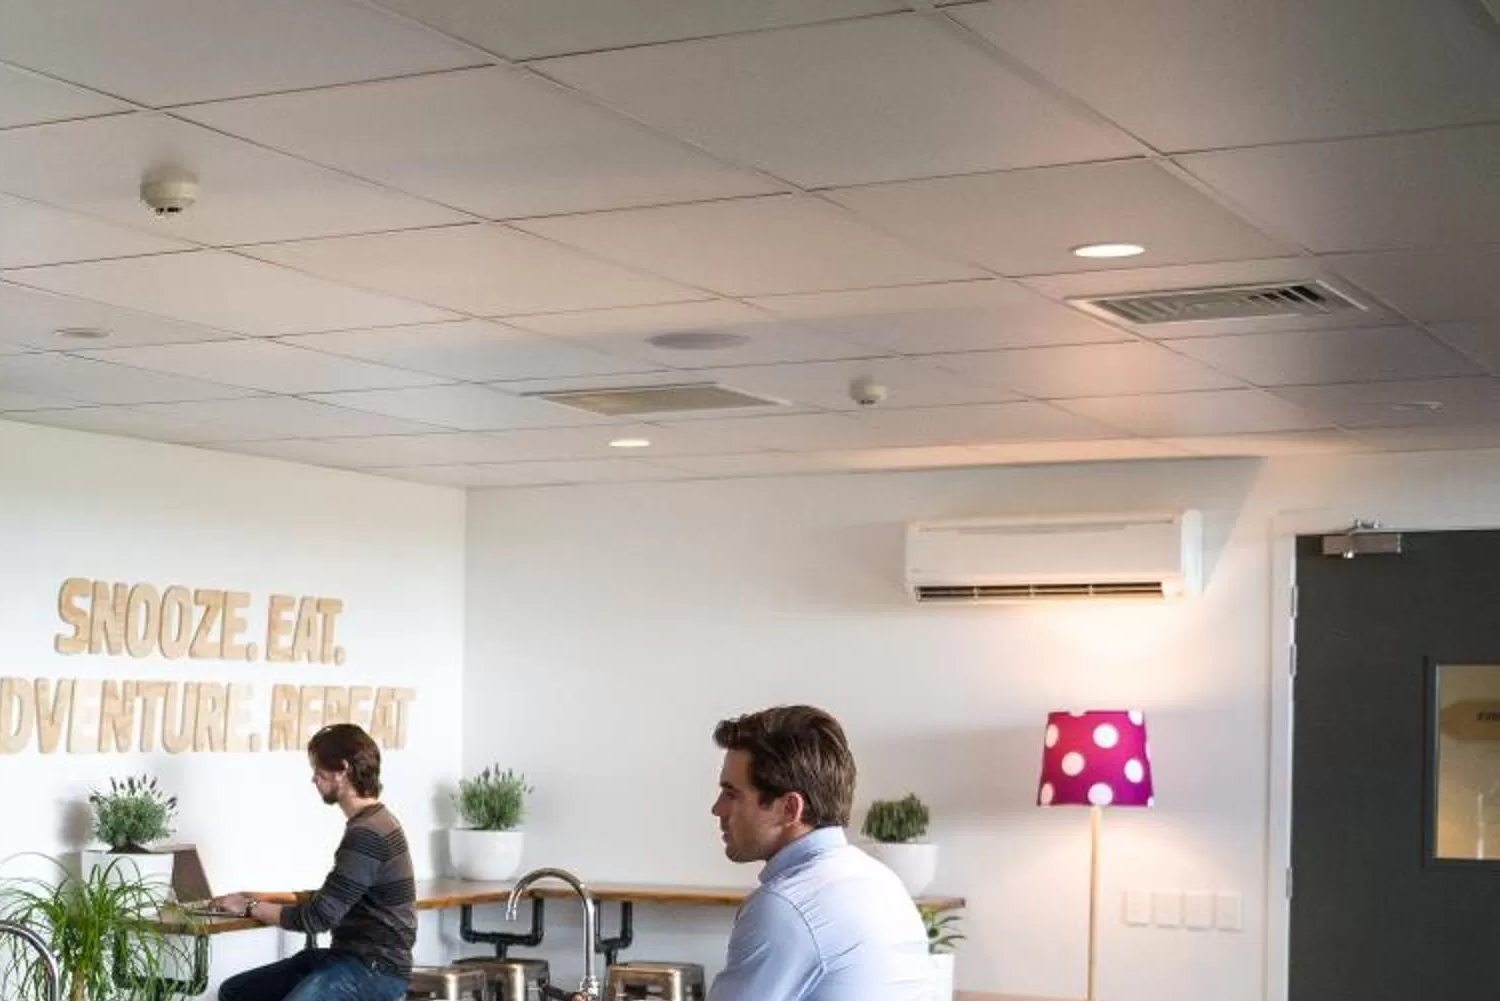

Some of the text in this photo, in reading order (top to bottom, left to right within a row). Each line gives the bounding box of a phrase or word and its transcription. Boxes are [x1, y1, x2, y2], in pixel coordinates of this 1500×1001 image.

[53, 577, 346, 666] SNOOZE. EAT.
[268, 683, 417, 751] REPEAT
